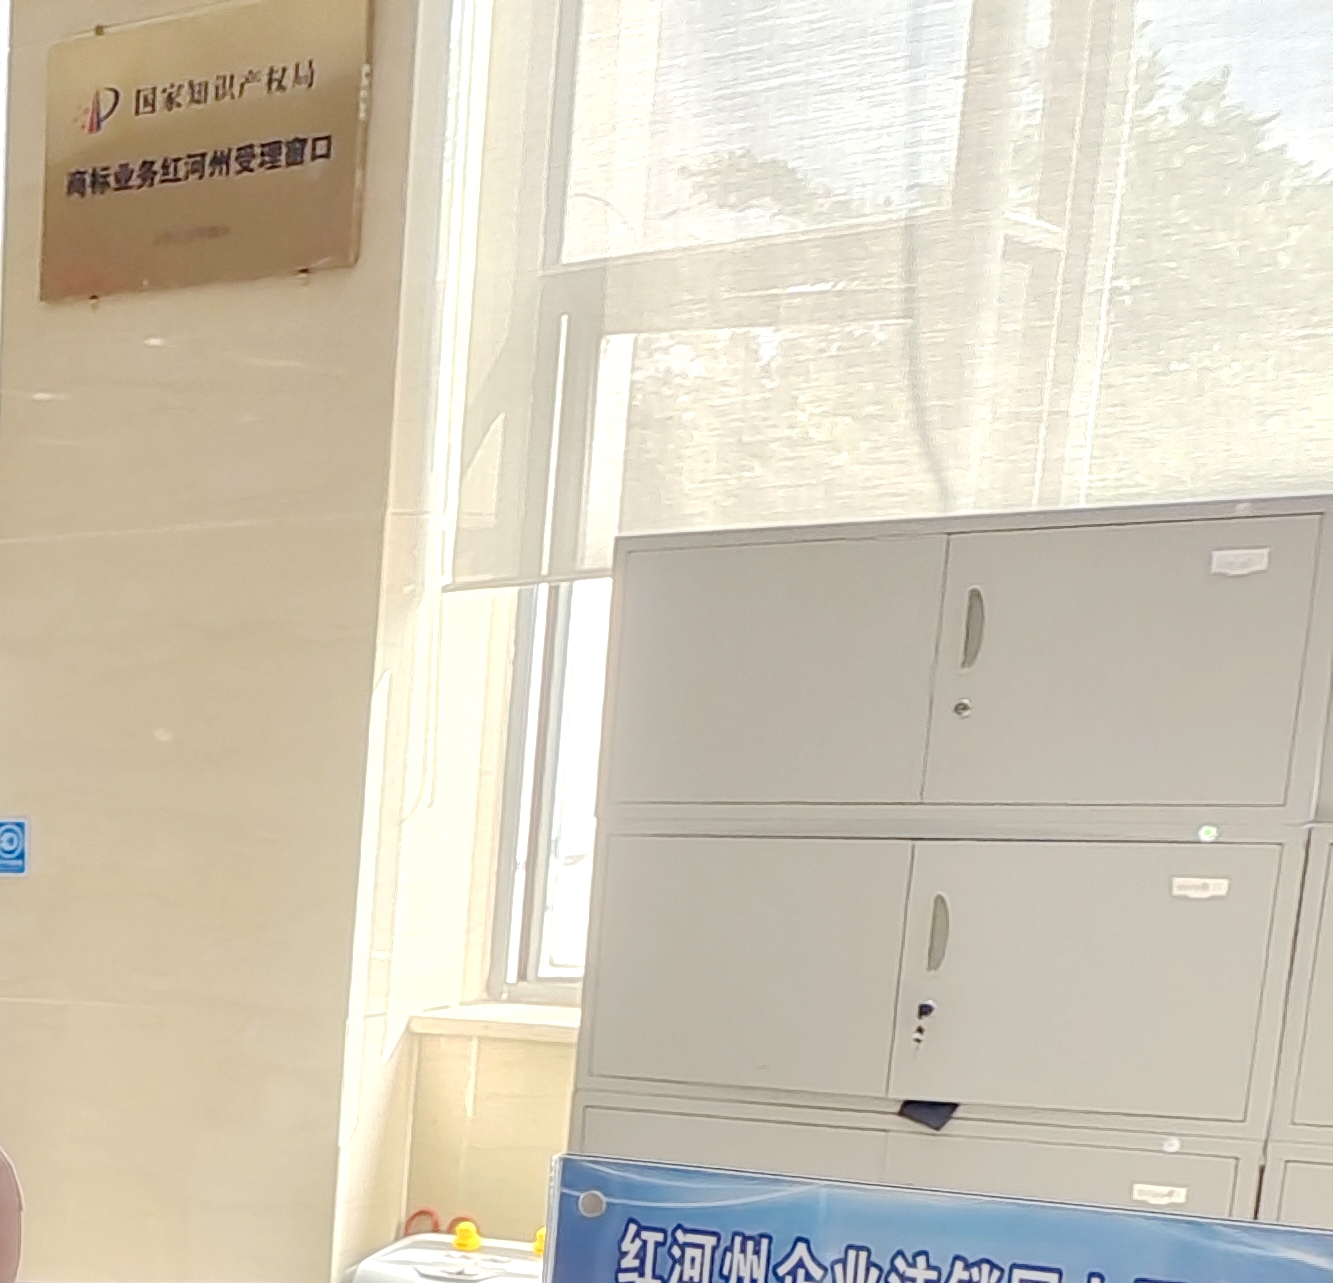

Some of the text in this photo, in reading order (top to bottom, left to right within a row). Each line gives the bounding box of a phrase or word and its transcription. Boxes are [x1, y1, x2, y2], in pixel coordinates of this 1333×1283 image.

[134, 59, 316, 116] 国家知识产权局
[65, 134, 333, 198] 商标业务红河州受理窗口
